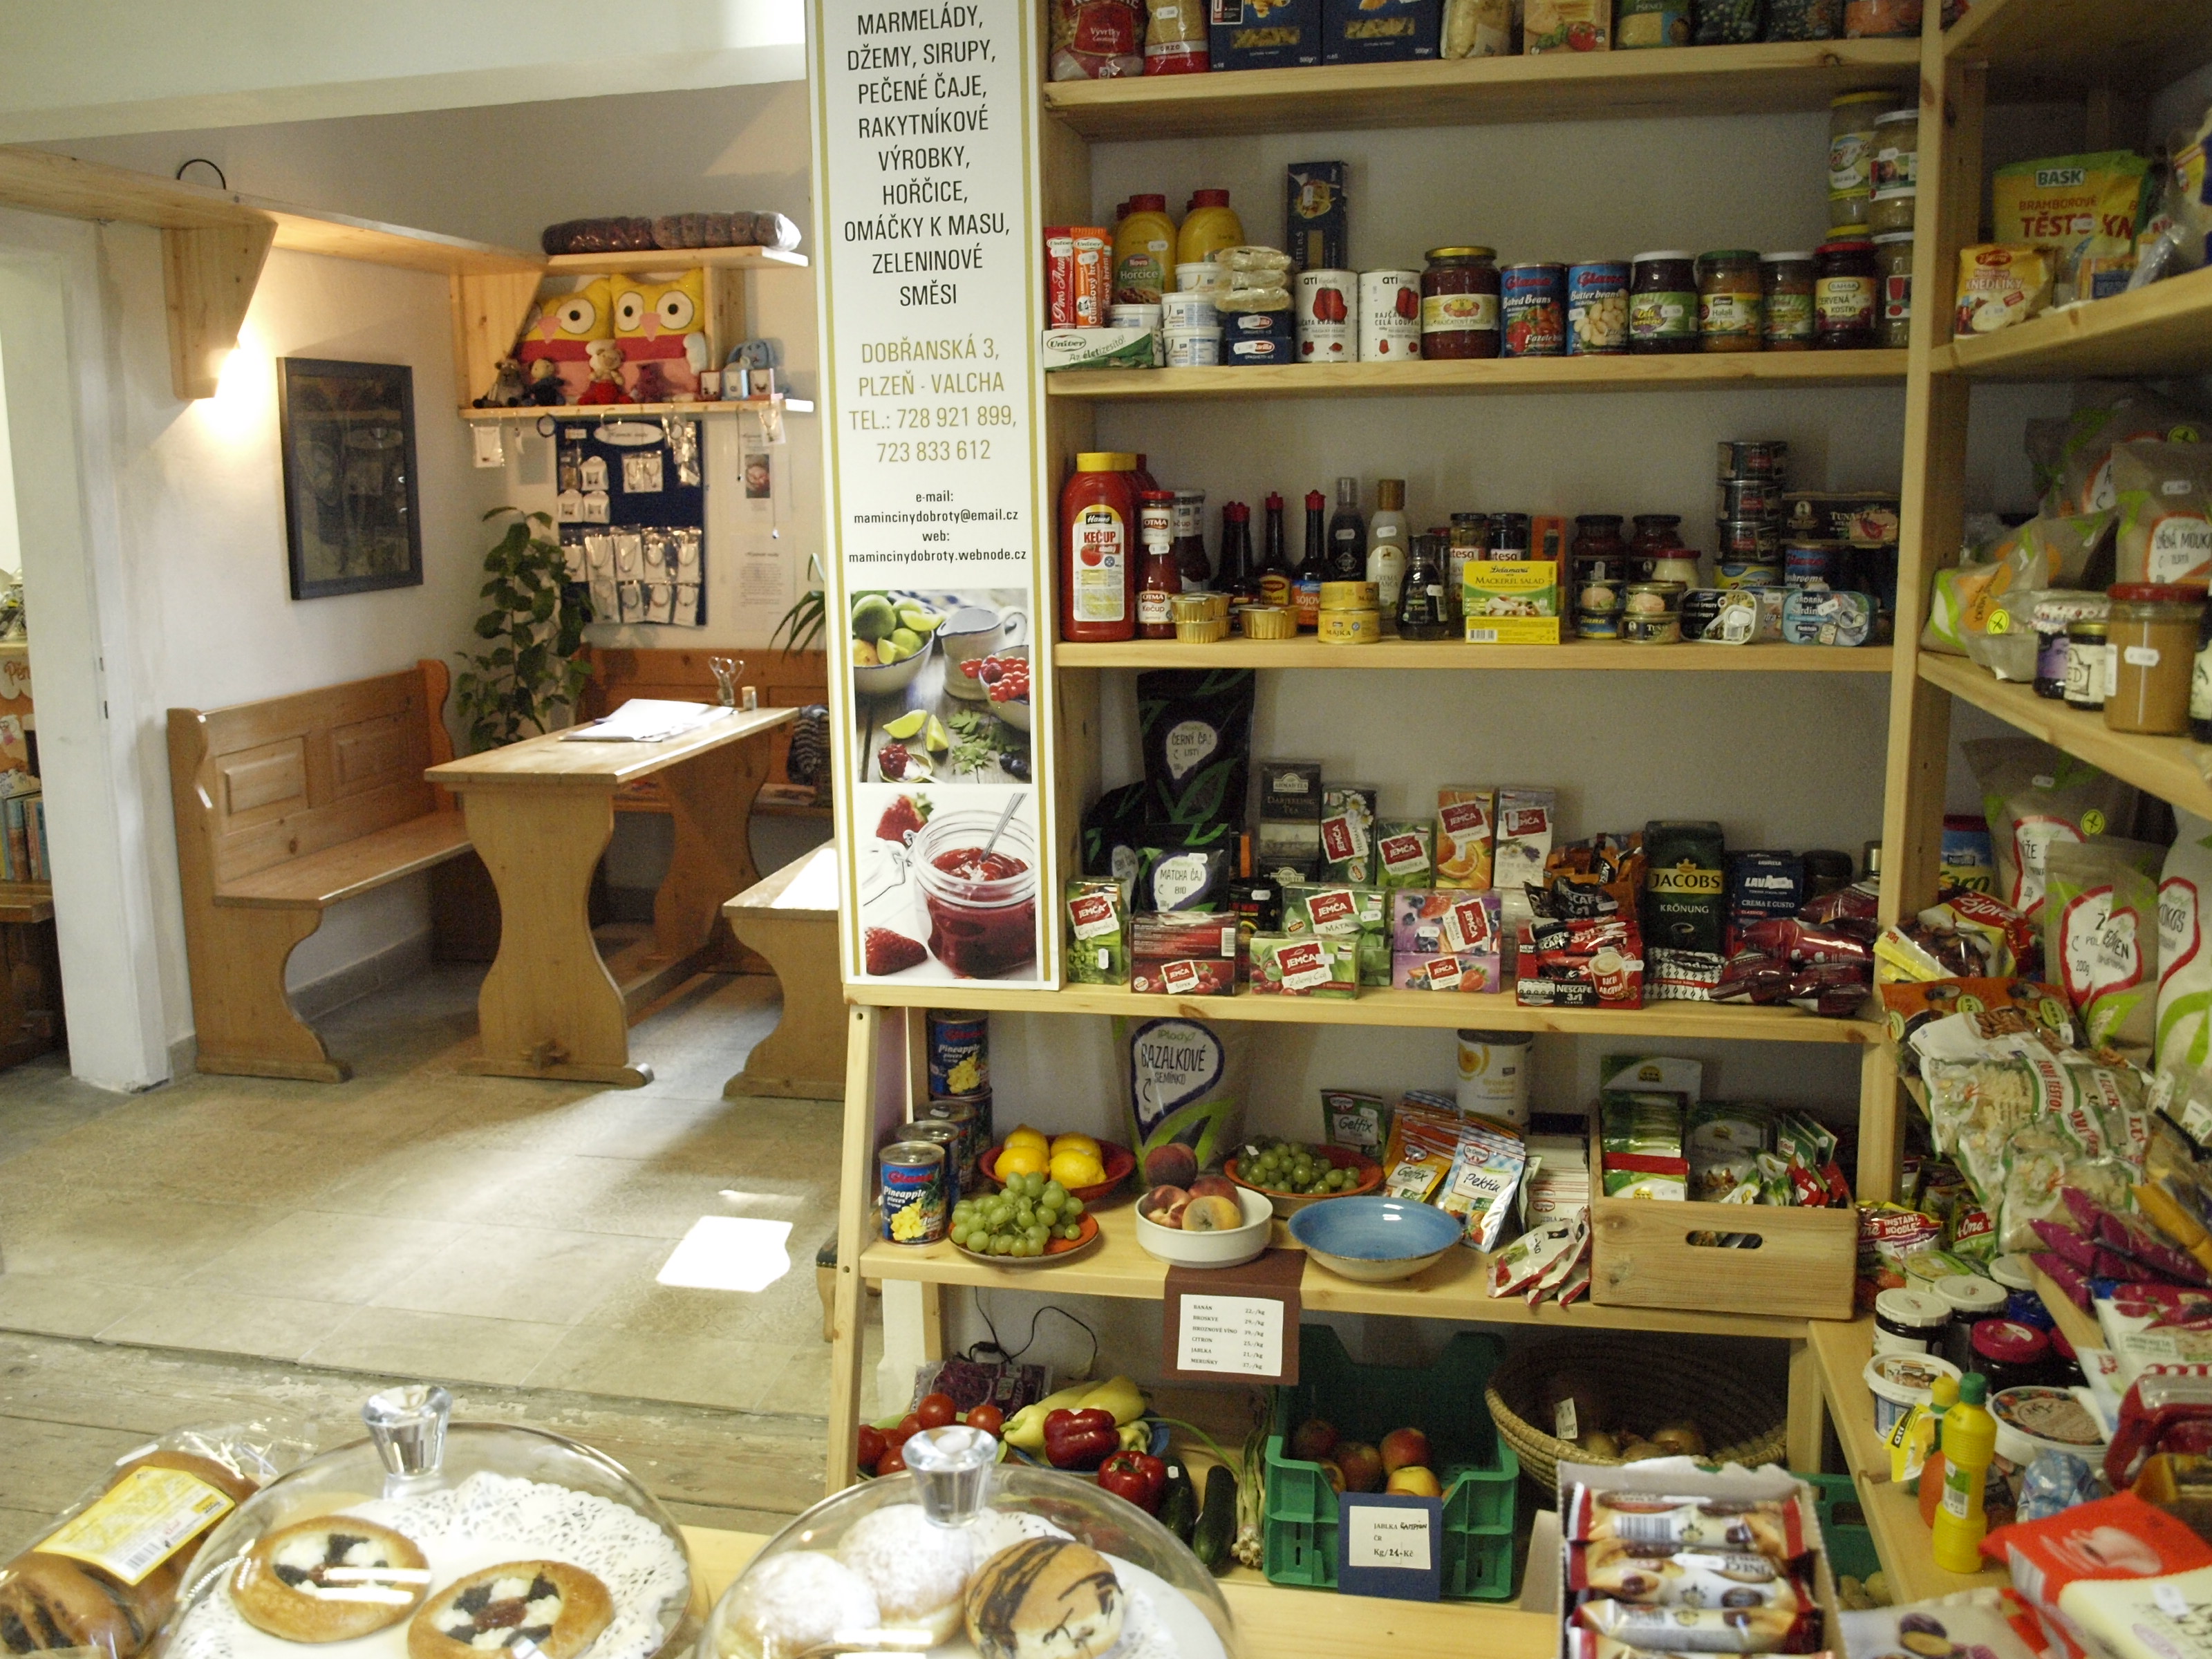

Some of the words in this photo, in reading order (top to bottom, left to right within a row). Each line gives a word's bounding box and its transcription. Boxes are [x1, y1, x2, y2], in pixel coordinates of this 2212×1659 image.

[858, 2, 983, 35] MARMELÁDY,
[847, 44, 917, 71] DŽEMY,
[924, 39, 996, 64] SIRUPY,
[859, 73, 928, 104] PEČENÉ
[935, 73, 987, 98] ČAJE,
[859, 104, 988, 139] RAKYTNÍKOVÉ
[879, 144, 970, 171] VÝROBKY,
[2038, 170, 2082, 185] BASK
[883, 177, 968, 205] HOŘČICE,
[2018, 196, 2097, 211] BRAMBOROVÉ
[845, 213, 924, 241] OMÁČKY
[931, 216, 941, 237] K
[948, 212, 1010, 236] MASU,
[872, 243, 983, 274] ZELENINOVÉ
[899, 279, 957, 306] SMĚSI
[1525, 294, 1551, 304] Beans
[1571, 290, 1593, 301] Butter
[1595, 290, 1620, 299] beans
[862, 333, 977, 363] DOBŘANSKÁ
[984, 338, 999, 360] 3,
[859, 370, 914, 397] PLZEŇ
[931, 372, 1004, 393] VALCHA
[849, 411, 890, 430] TEL.:
[897, 408, 930, 429] 728
[937, 406, 968, 427] 921
[977, 405, 1016, 427] 899,
[877, 442, 910, 462] 723
[917, 441, 950, 462] 833
[957, 440, 991, 460] 612
[916, 490, 954, 503] e-mail:
[854, 509, 1018, 525] mamincinydobroty@email.cz
[922, 530, 950, 542] web:
[1083, 529, 1116, 543] KEČUP
[849, 548, 1027, 564] mamincinydobroty.webnode.cz
[1142, 604, 1165, 613] Kečup
[1450, 812, 1477, 826] JEMČA
[1389, 843, 1416, 858] JEMČA
[1159, 869, 1188, 881] MATCHA
[1190, 869, 1203, 882] ČAJ
[1650, 874, 1721, 889] JACOBS
[1078, 904, 1105, 918] JEMČA
[1318, 903, 1347, 917] JEMČA
[1660, 903, 1709, 914] KRÖNUNG
[1742, 899, 1766, 908] CREMA
[1463, 910, 1478, 938] JEMČA
[1286, 953, 1316, 969] JEMČA
[1169, 967, 1190, 979] JEMČA
[1434, 964, 1454, 975] JEMČA
[938, 1043, 980, 1053] Pineapple
[1141, 1044, 1206, 1071] BAZALKOVÉ
[1154, 1071, 1185, 1085] SEMÍNKO
[1338, 1116, 1373, 1134] Gelfix
[1397, 1167, 1429, 1183] Gelfix
[1464, 1172, 1500, 1193] Pektin
[883, 1185, 926, 1199] Pineapple
[1884, 1215, 1918, 1226] INSTANT
